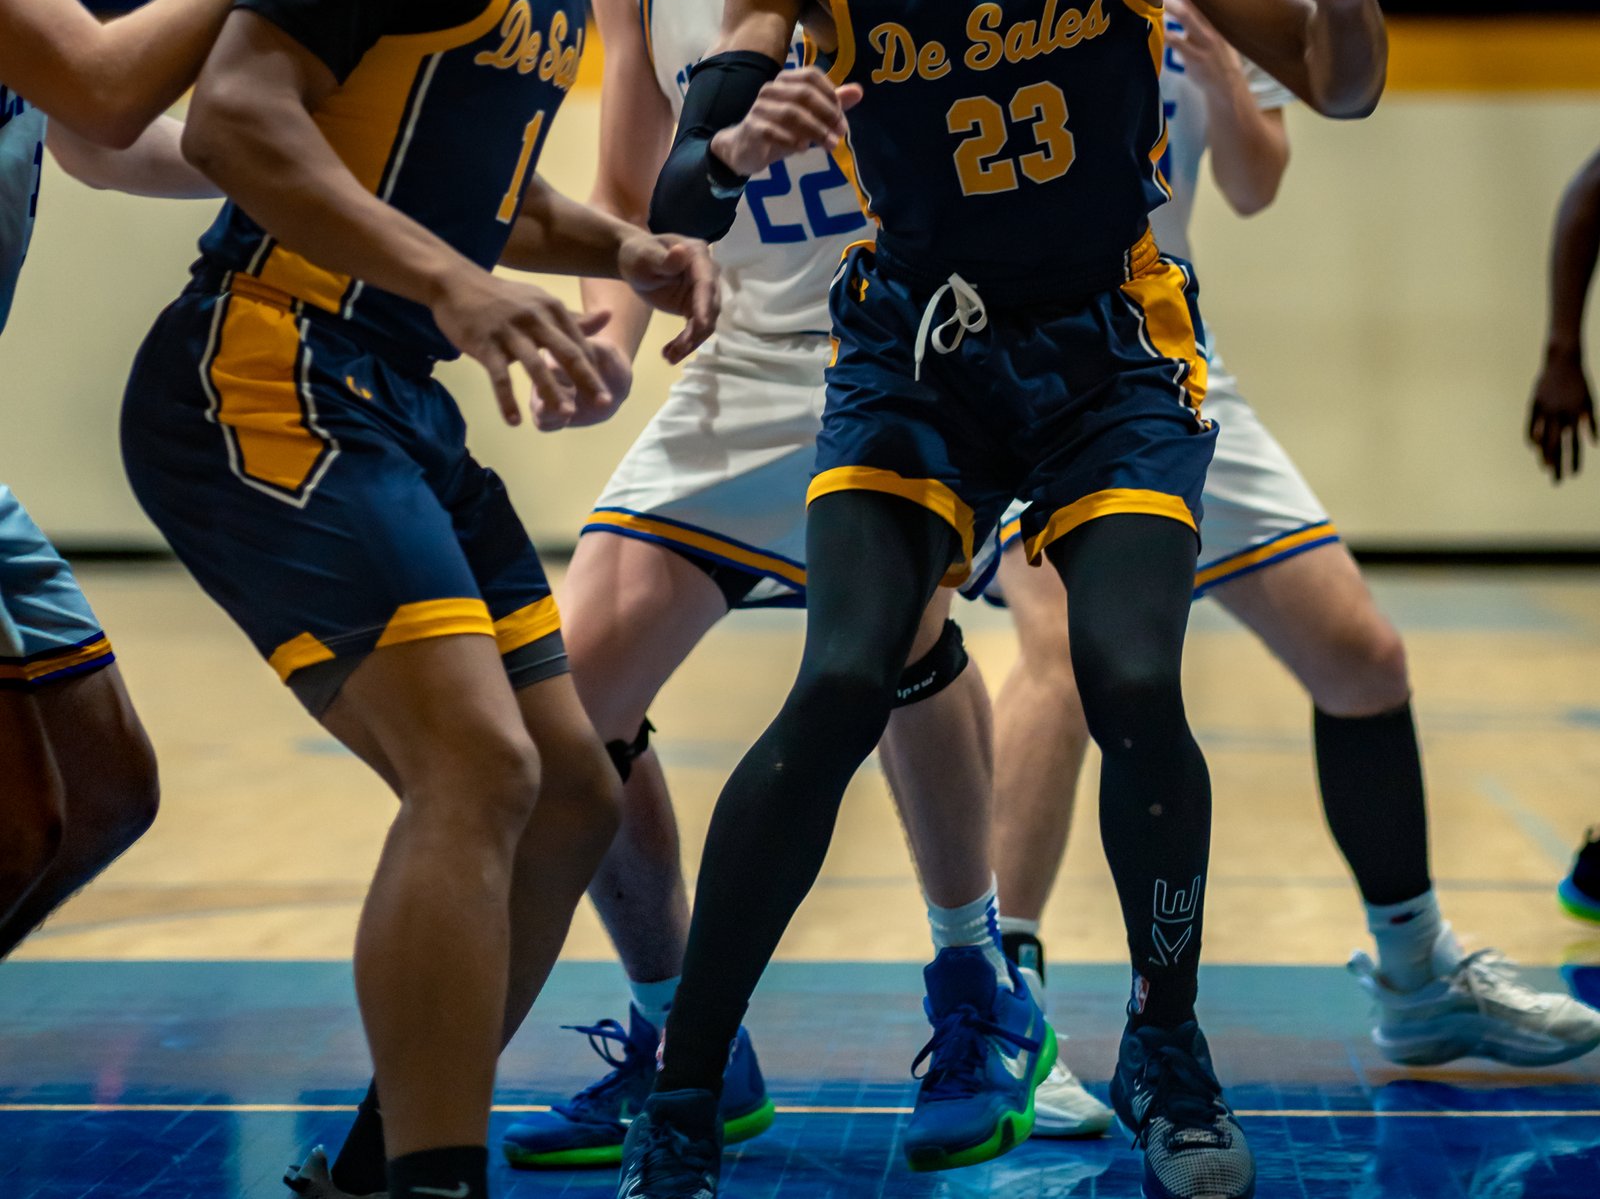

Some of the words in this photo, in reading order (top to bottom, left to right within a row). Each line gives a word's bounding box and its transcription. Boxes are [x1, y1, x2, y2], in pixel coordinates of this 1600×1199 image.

[868, 21, 952, 84] De
[495, 110, 546, 225] 1
[744, 140, 868, 244] 22
[945, 80, 1077, 197] 23
